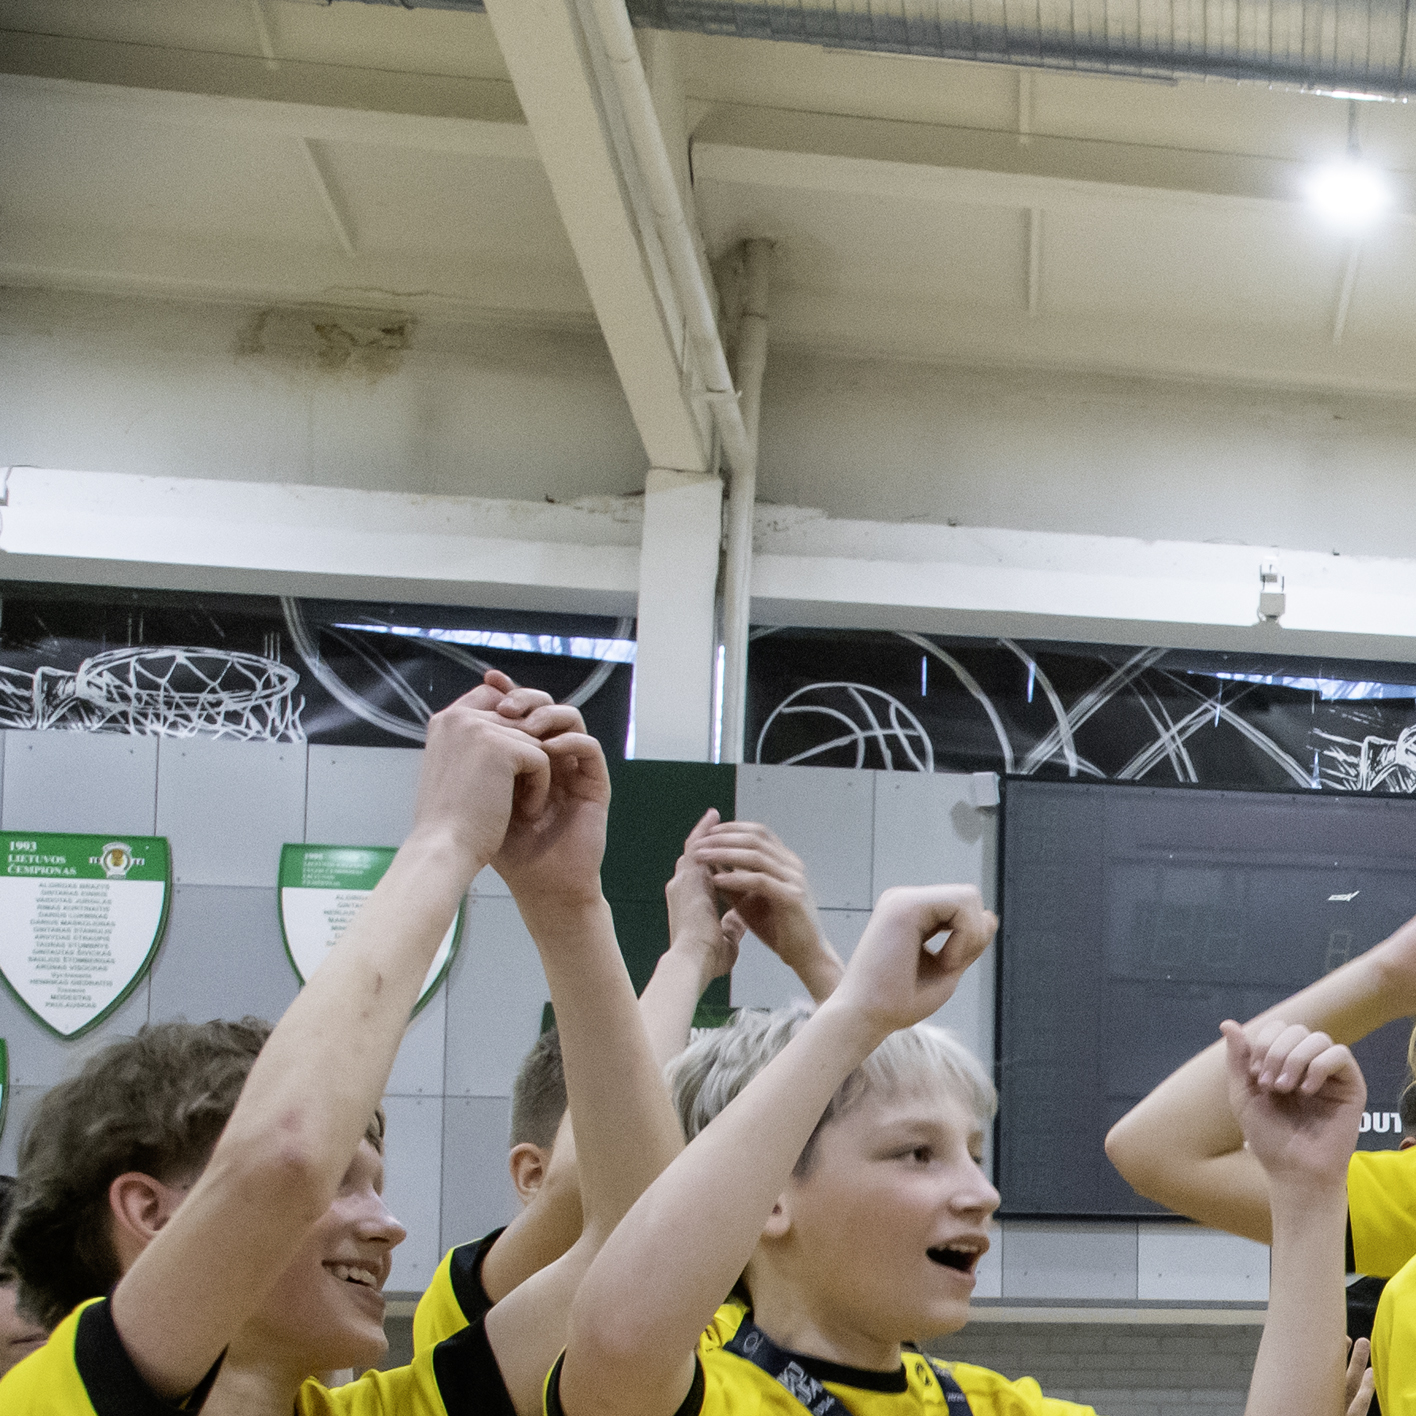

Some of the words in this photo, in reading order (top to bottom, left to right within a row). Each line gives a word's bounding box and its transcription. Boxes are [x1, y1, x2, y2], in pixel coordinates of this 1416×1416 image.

[10, 841, 37, 851] 1993
[8, 854, 66, 864] LIETUVOS
[7, 865, 77, 876] ČEMPIONAS
